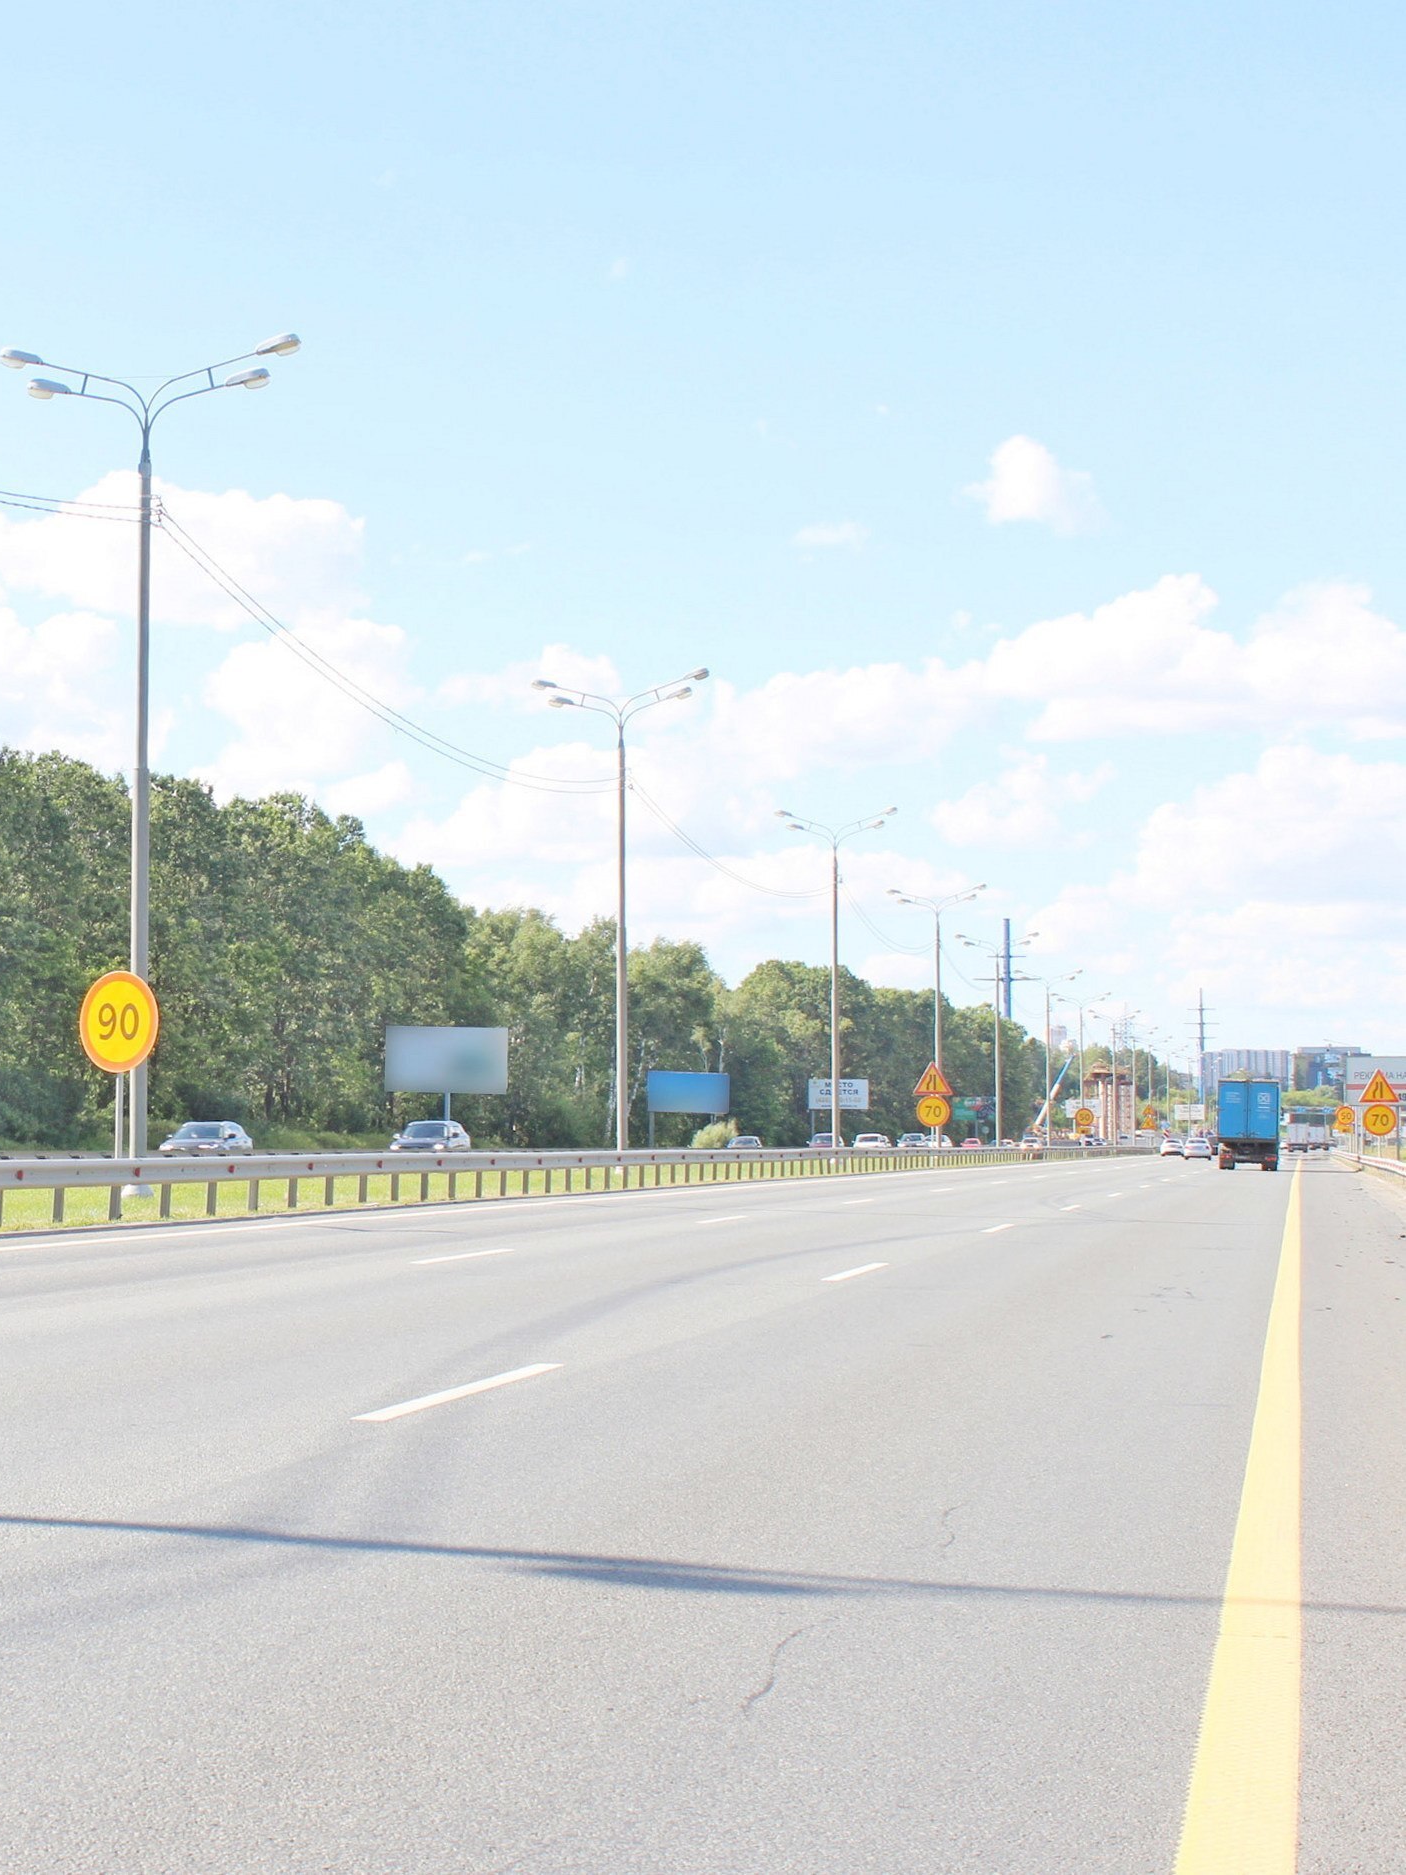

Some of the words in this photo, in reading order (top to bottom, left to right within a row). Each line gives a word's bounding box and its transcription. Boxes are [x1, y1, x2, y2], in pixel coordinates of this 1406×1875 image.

[98, 1002, 140, 1041] 90
[819, 1088, 859, 1096] СДЕТСЯ
[924, 1105, 942, 1118] 70
[1340, 1112, 1352, 1121] 50
[1079, 1113, 1091, 1122] 50
[1371, 1113, 1390, 1127] 70
